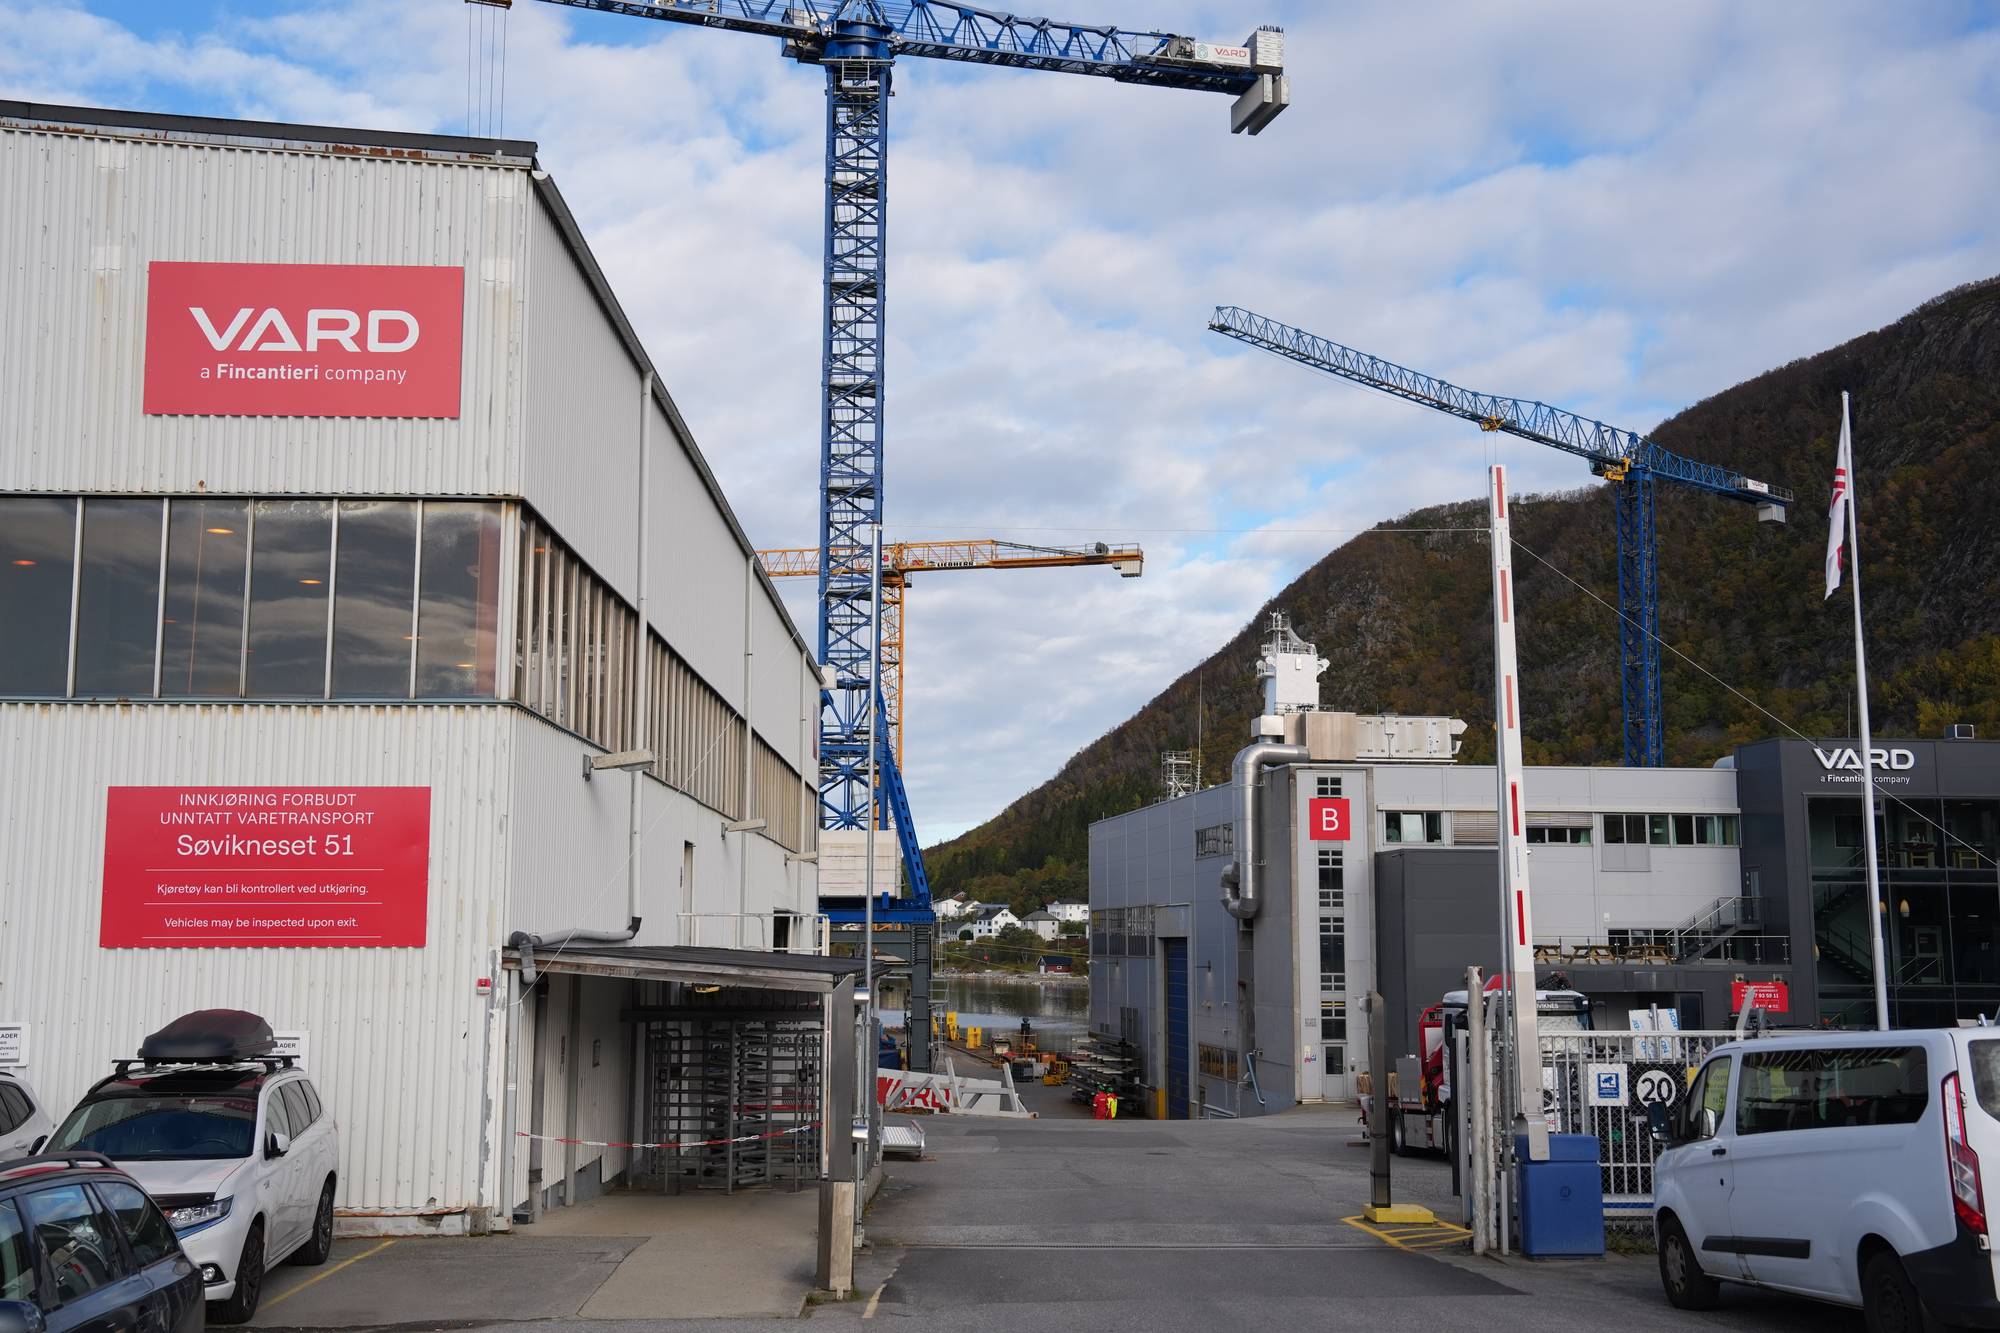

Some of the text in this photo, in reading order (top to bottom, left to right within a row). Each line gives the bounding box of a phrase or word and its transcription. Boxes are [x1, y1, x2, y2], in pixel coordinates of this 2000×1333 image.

[1215, 47, 1247, 58] VARD
[188, 306, 420, 353] VARD
[200, 363, 407, 385] a Fincantieri company
[1813, 748, 1915, 770] VARD
[1873, 776, 1910, 784] company
[180, 793, 357, 806] INNKJØRING FORBUDT
[160, 811, 375, 825] UNNTATT VARETRANSPORT
[1322, 807, 1339, 831] B
[177, 834, 354, 856] Søvikneset 51
[157, 884, 369, 896] Kjøretøy kan bli kontrollert ved utkjøring.
[164, 917, 359, 930] Vehicles may be inspected upon exit.
[1641, 1077, 1673, 1103] 20
